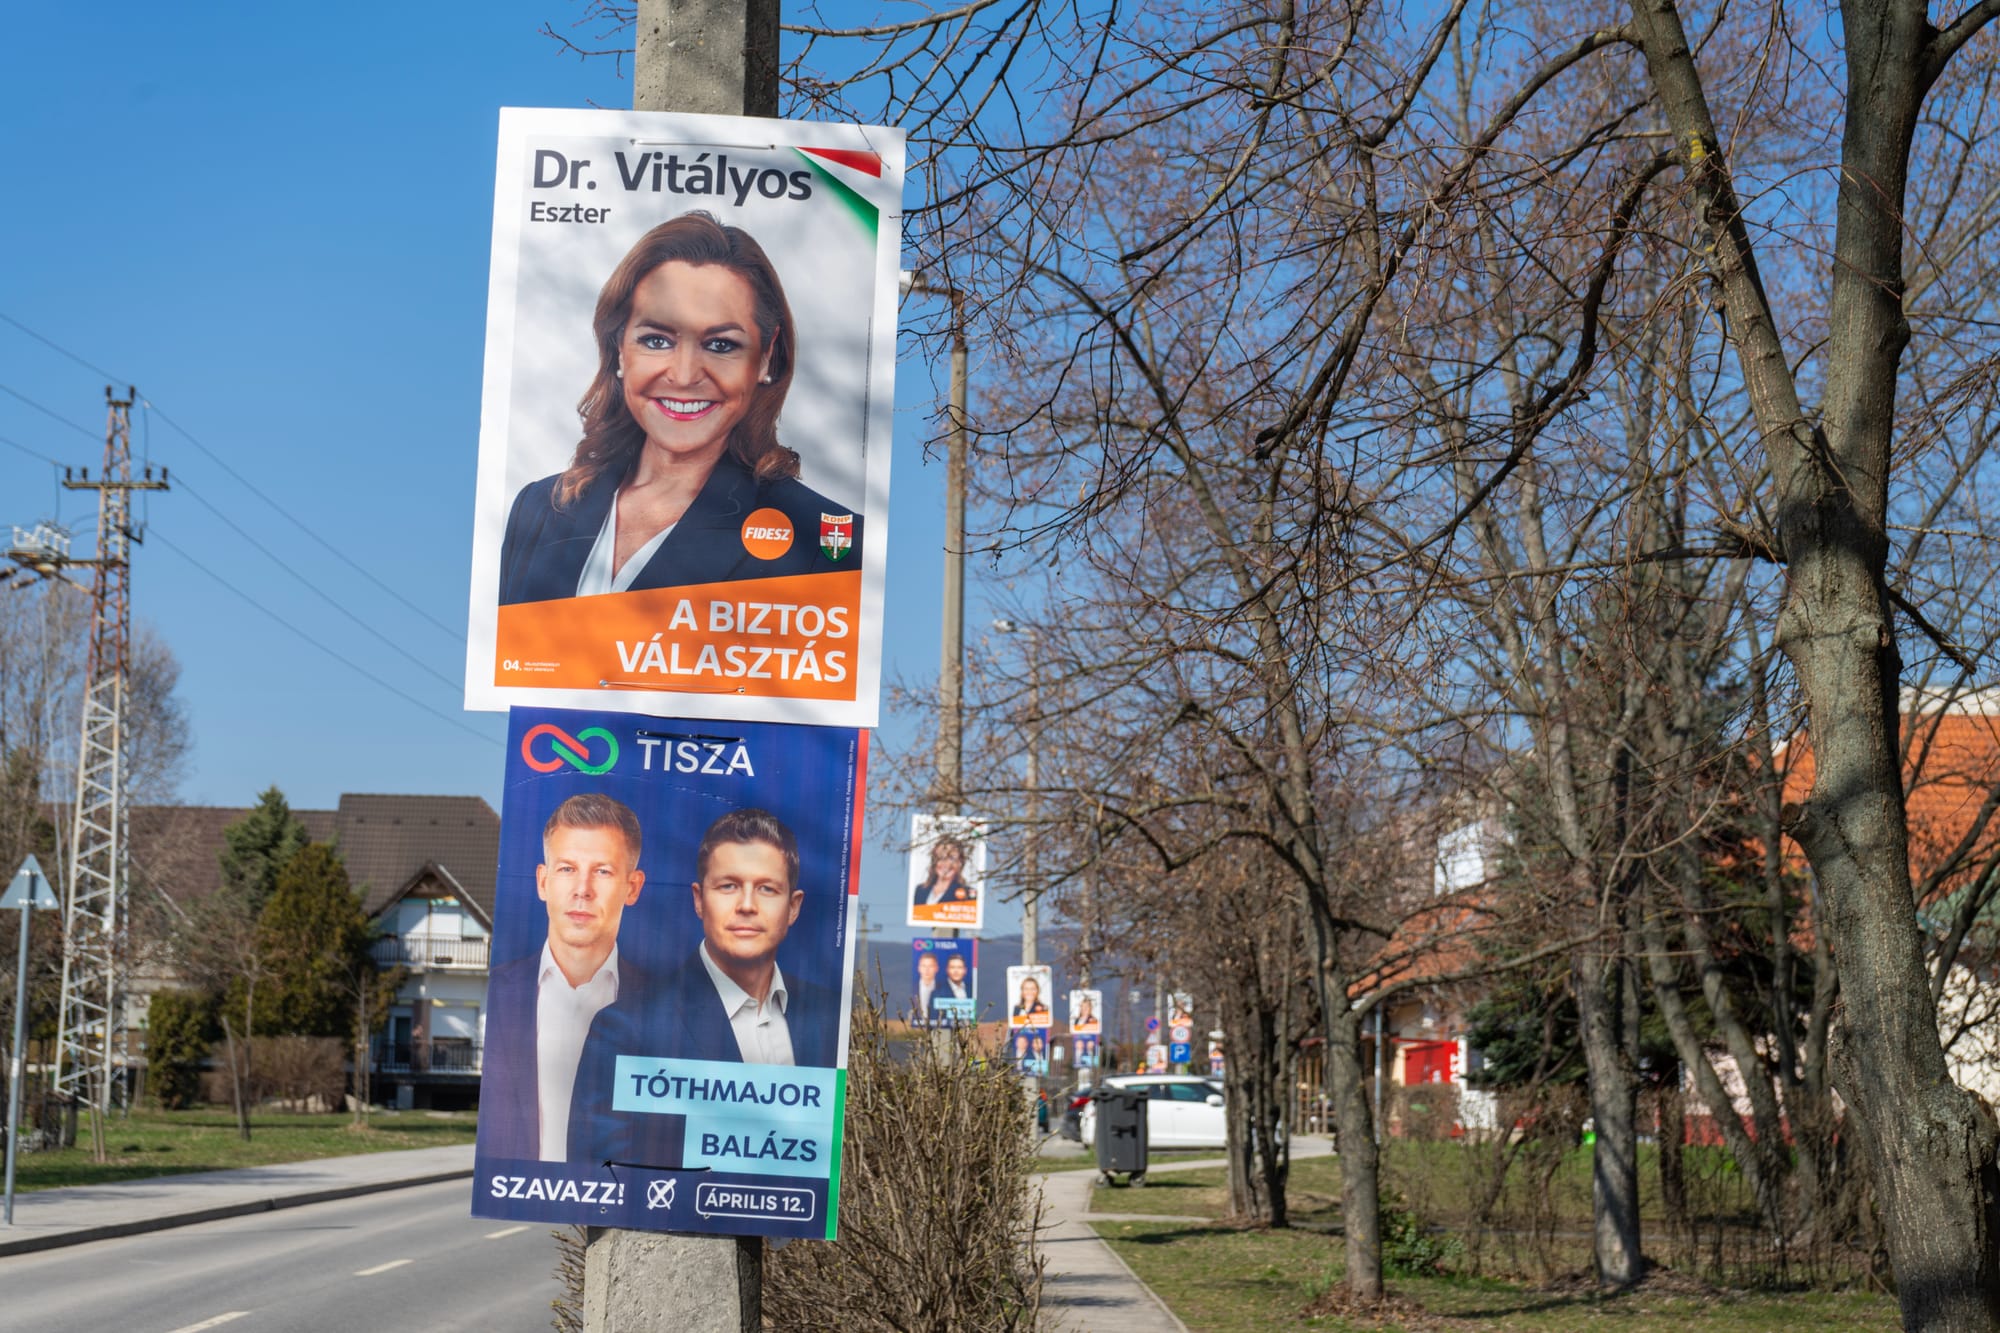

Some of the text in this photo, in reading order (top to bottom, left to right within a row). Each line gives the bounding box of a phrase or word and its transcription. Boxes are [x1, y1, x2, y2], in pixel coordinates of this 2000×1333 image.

[533, 149, 813, 207] Dr. Vitályos
[530, 201, 611, 224] Eszter
[744, 527, 791, 541] FIDESZ
[668, 599, 849, 638] A BIZTOS
[503, 659, 523, 672] 04.
[616, 632, 847, 683] VÁLASZTÁS
[637, 738, 755, 777] TISZA
[631, 1069, 821, 1107] TÓTHMAJOR
[701, 1130, 817, 1162] BALÁZS
[490, 1175, 625, 1205] SZAVAZZ!
[705, 1187, 806, 1213] ÁPRILIS 12.
